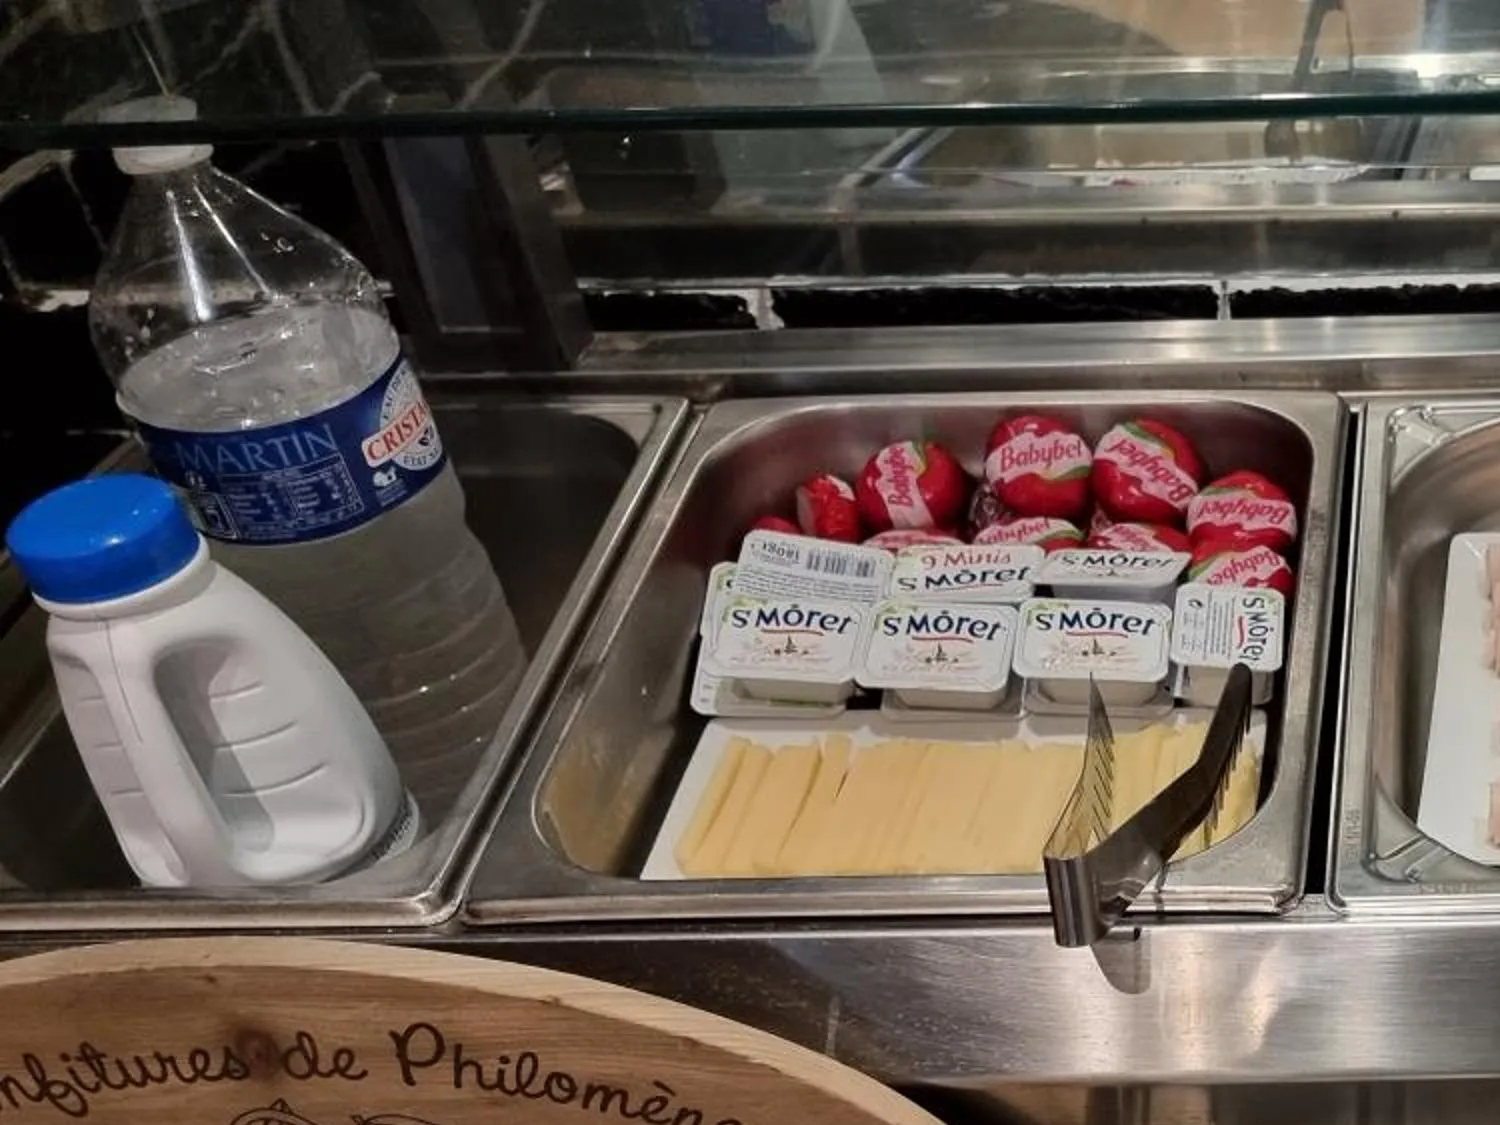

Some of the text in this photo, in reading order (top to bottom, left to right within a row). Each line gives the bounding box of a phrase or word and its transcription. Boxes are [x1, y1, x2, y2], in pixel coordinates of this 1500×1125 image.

[175, 423, 340, 472] MARTIN
[1001, 440, 1083, 472] Babybel
[1106, 439, 1194, 502] Babybel
[1197, 500, 1291, 525] Babybel
[922, 551, 1012, 568] 9 Minis
[1206, 550, 1282, 585] Babybe
[0, 1041, 250, 1118] nfitures
[283, 1031, 369, 1080] de
